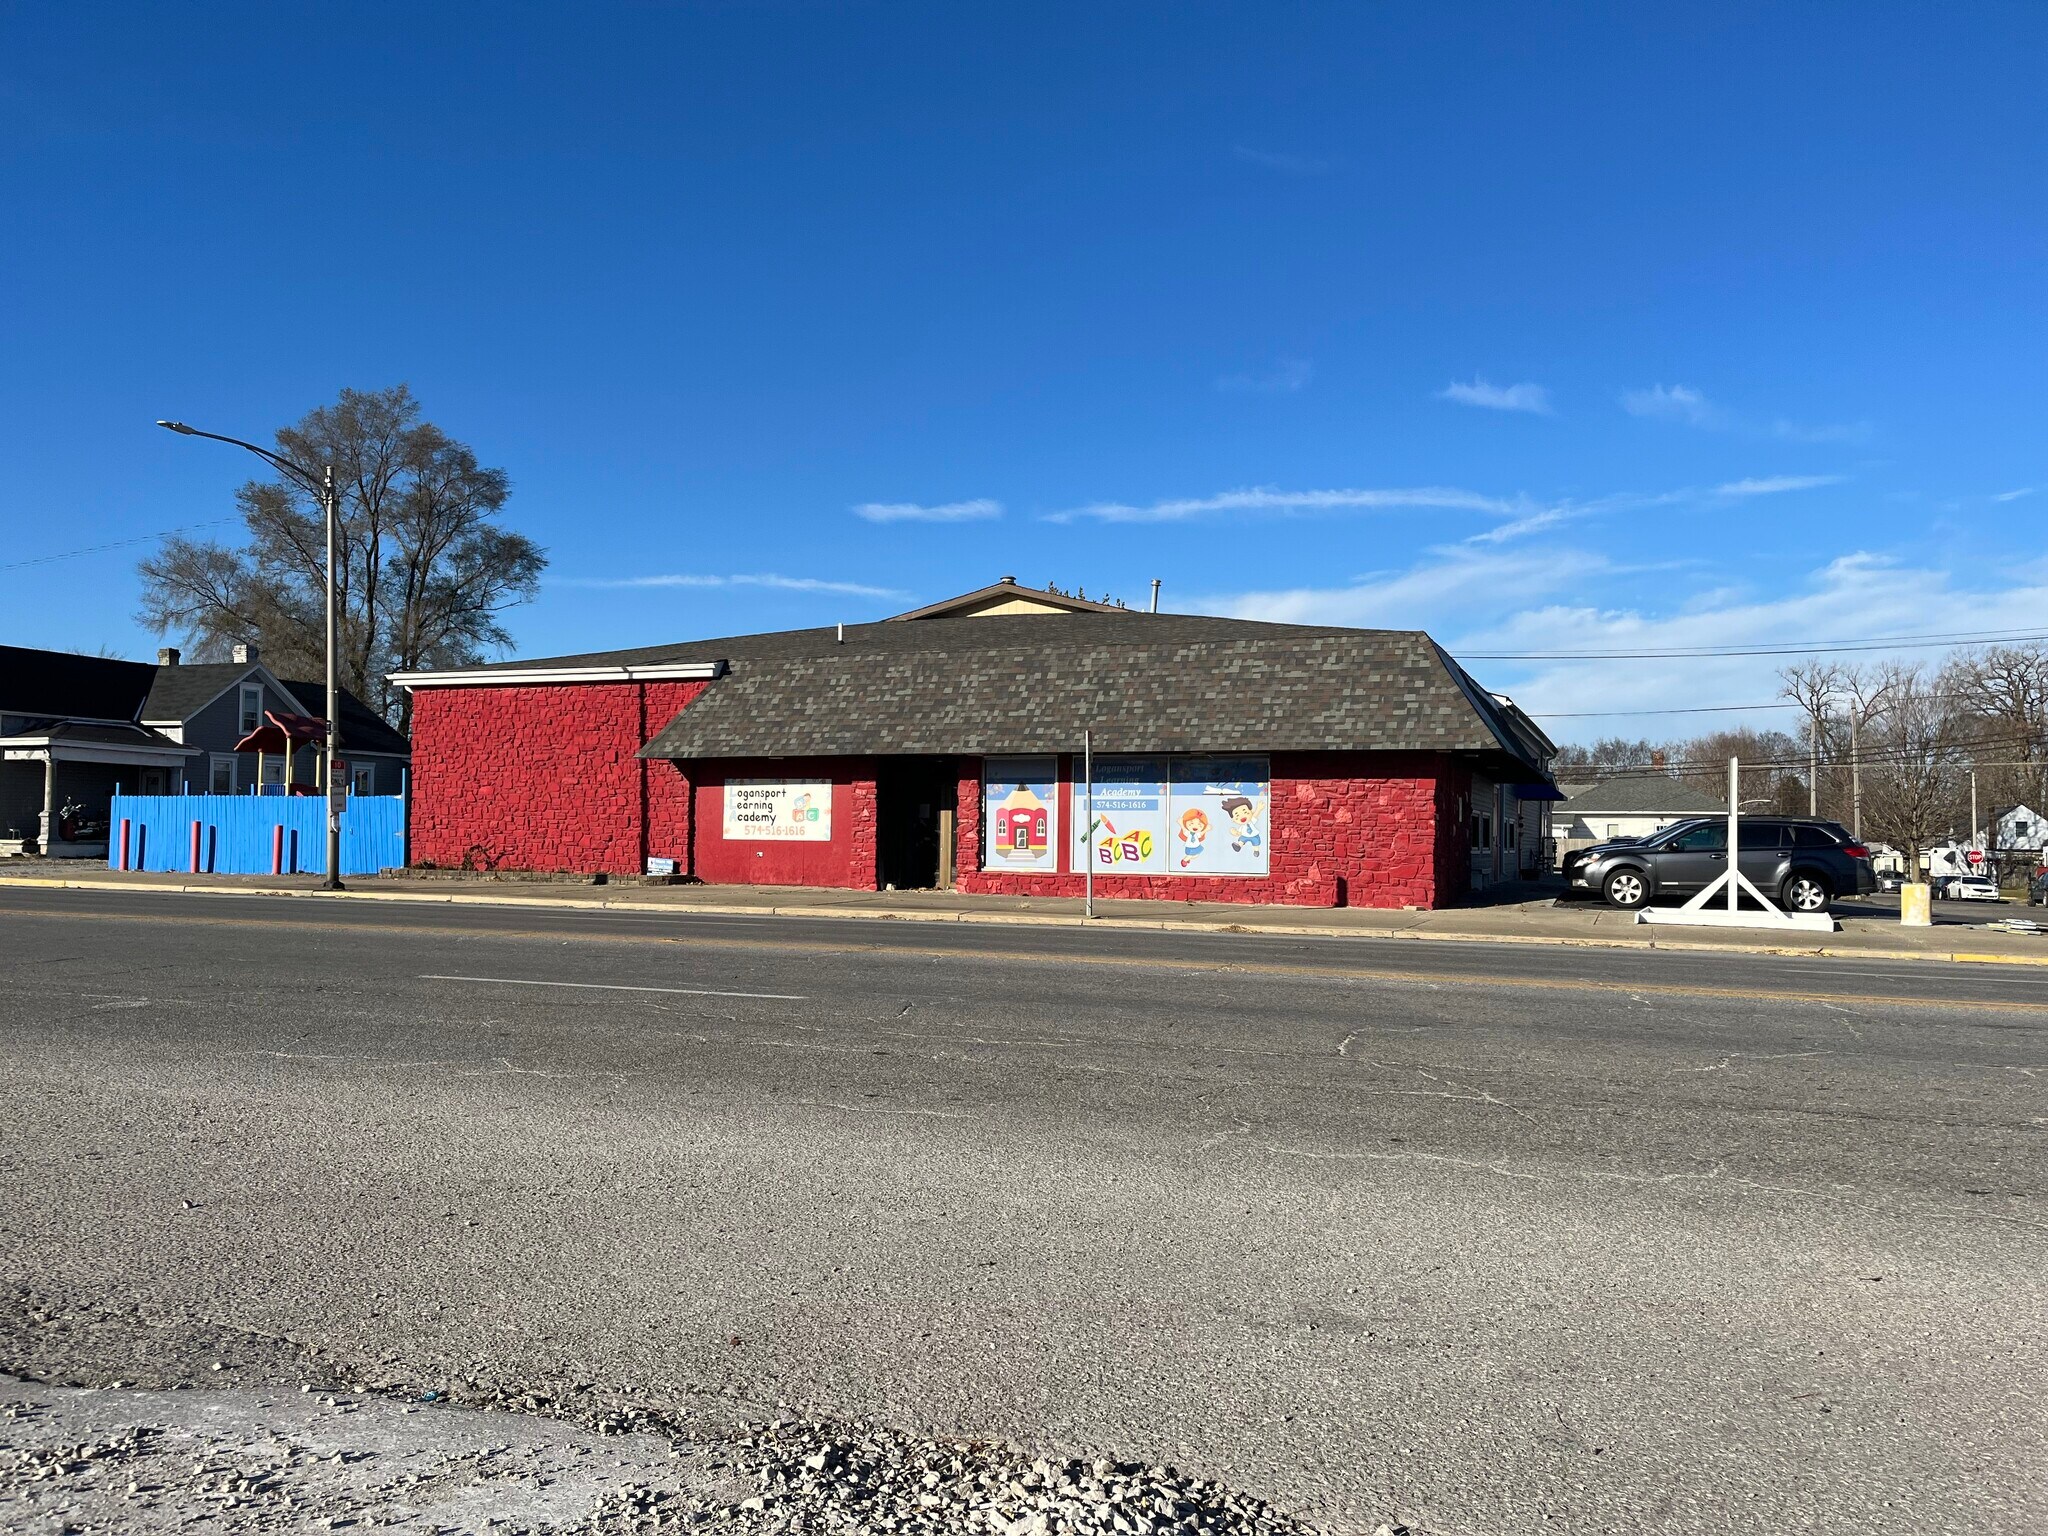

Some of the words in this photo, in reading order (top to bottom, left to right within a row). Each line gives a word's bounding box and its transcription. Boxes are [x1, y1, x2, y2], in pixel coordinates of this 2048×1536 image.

[1095, 764, 1144, 774] Logansport
[729, 787, 787, 801] Logansport
[1100, 788, 1141, 797] Academy
[729, 799, 773, 813] Learning
[1096, 801, 1147, 809] 574-516-1616
[729, 810, 777, 826] Academy
[744, 825, 806, 836] 574-516-1616
